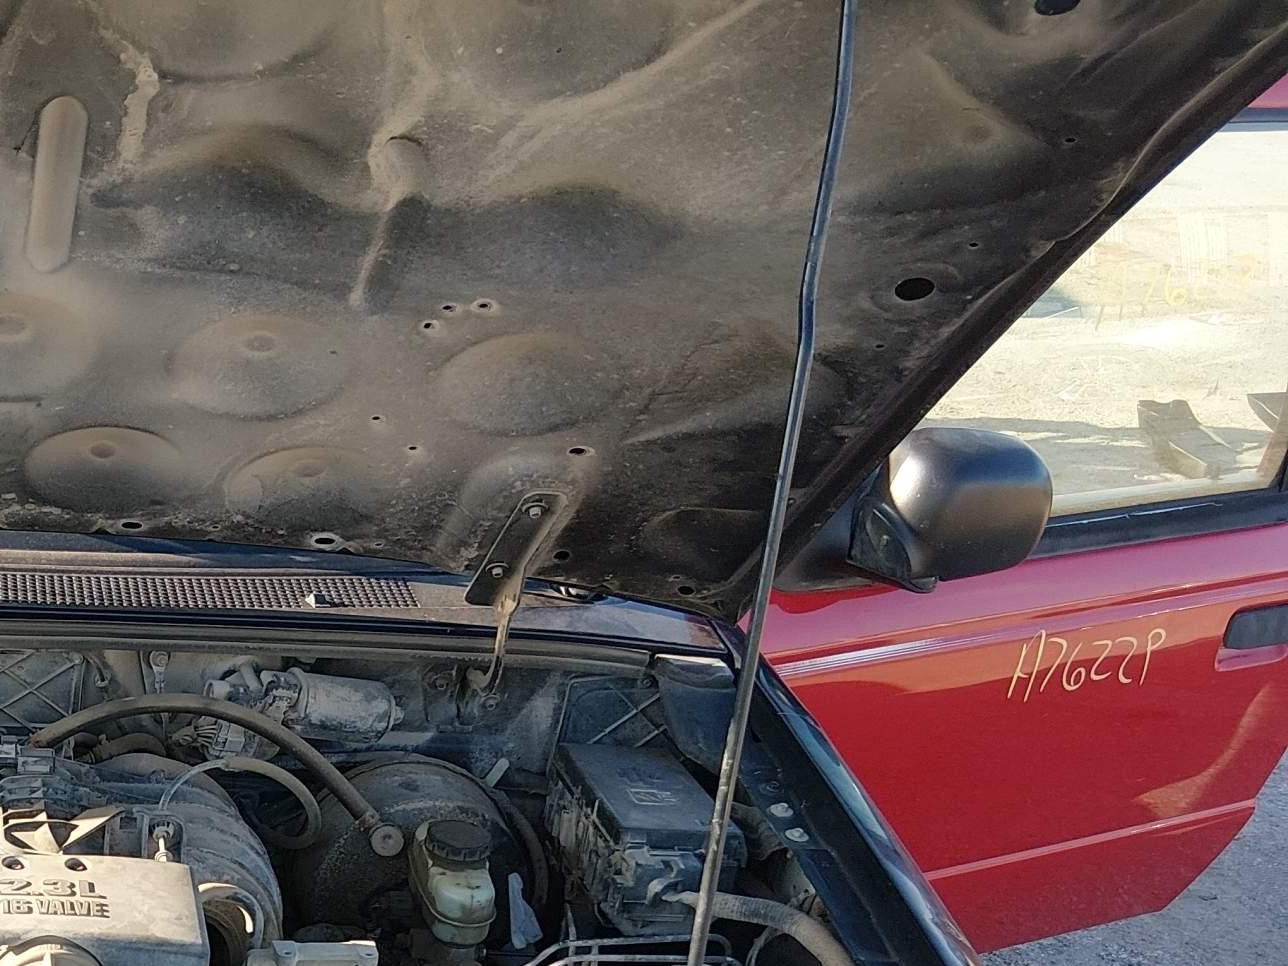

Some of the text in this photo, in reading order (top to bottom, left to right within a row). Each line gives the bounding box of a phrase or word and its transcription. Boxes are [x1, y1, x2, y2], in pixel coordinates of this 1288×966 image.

[1007, 628, 1167, 703] A7622P
[0, 878, 107, 899] 2.3L
[0, 899, 111, 918] 16 VALVE
